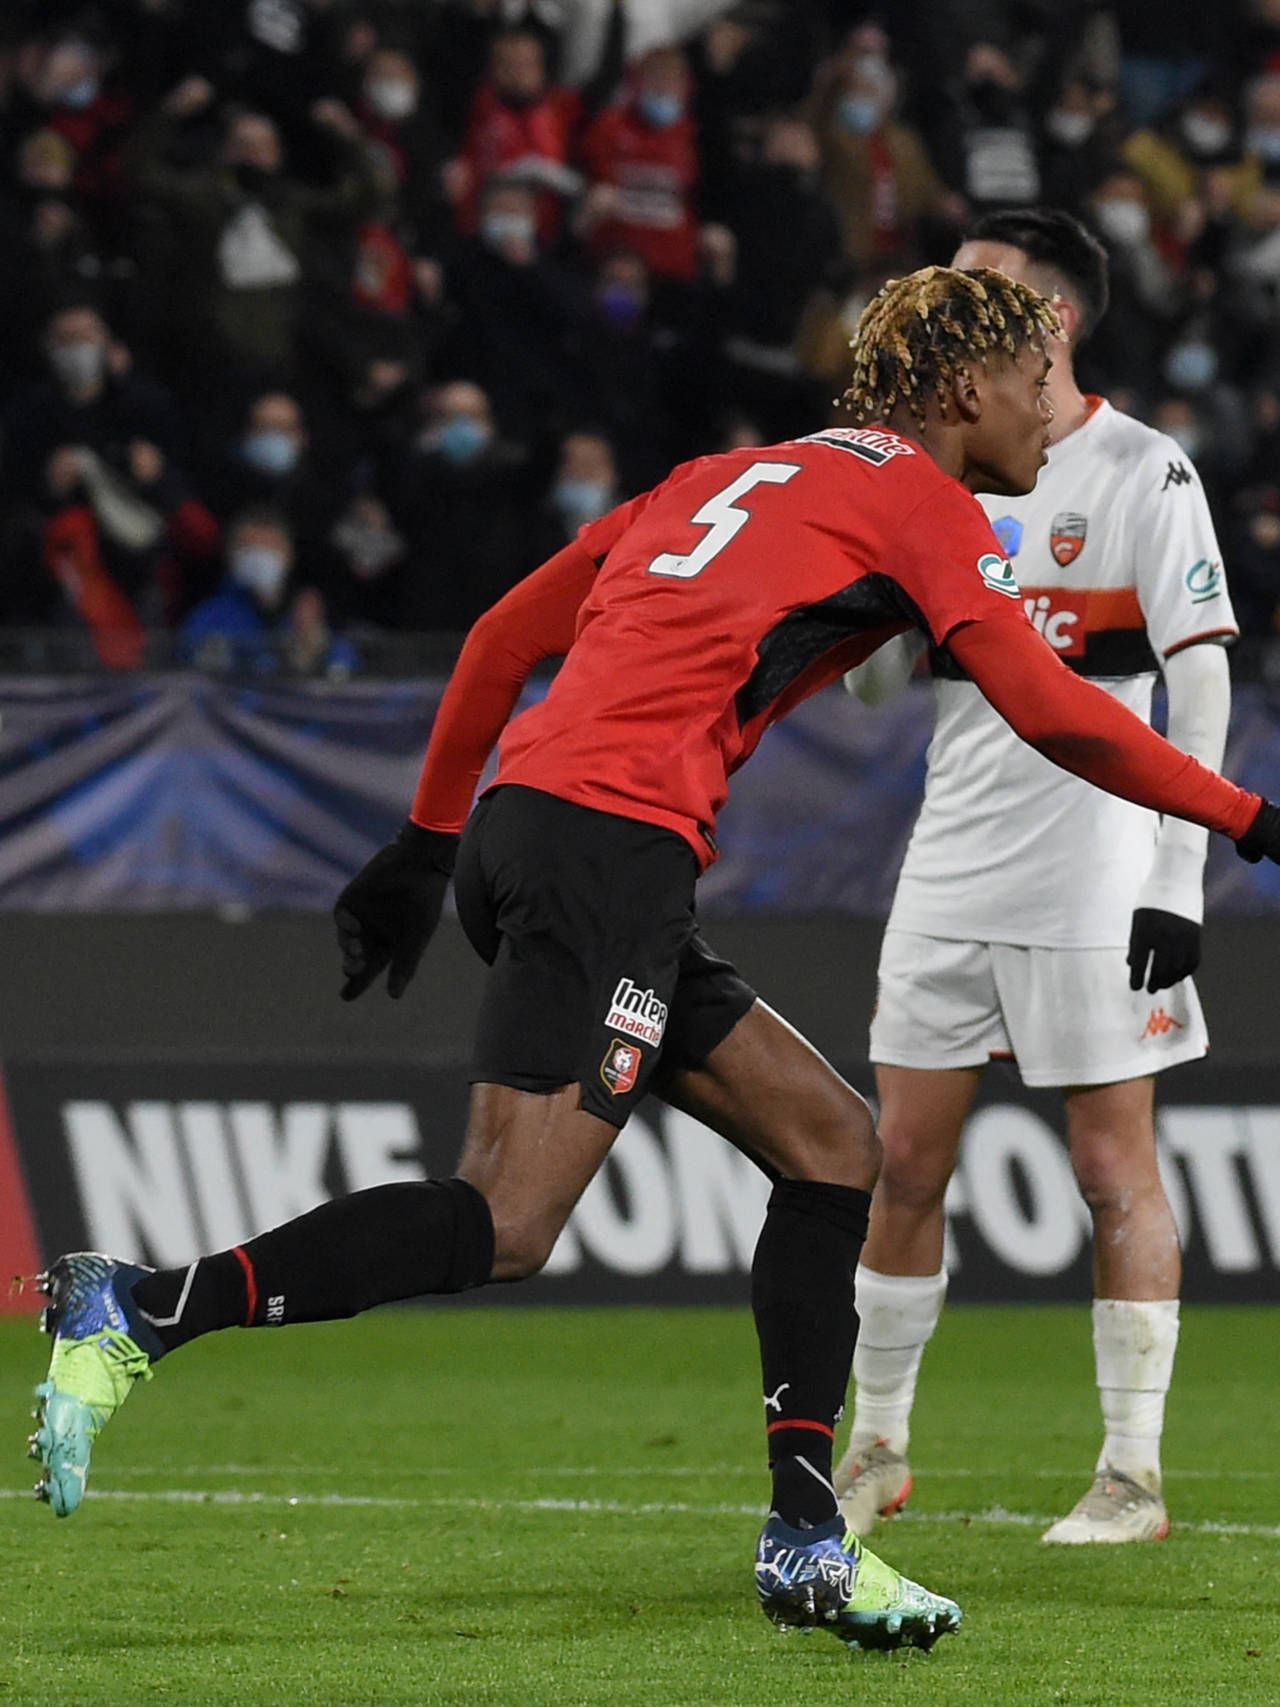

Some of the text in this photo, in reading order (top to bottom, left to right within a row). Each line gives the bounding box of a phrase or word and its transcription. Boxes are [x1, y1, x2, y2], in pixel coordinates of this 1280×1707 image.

[648, 461, 803, 579] 5
[62, 1103, 427, 1270] NIKE
[543, 1105, 775, 1275] ON
